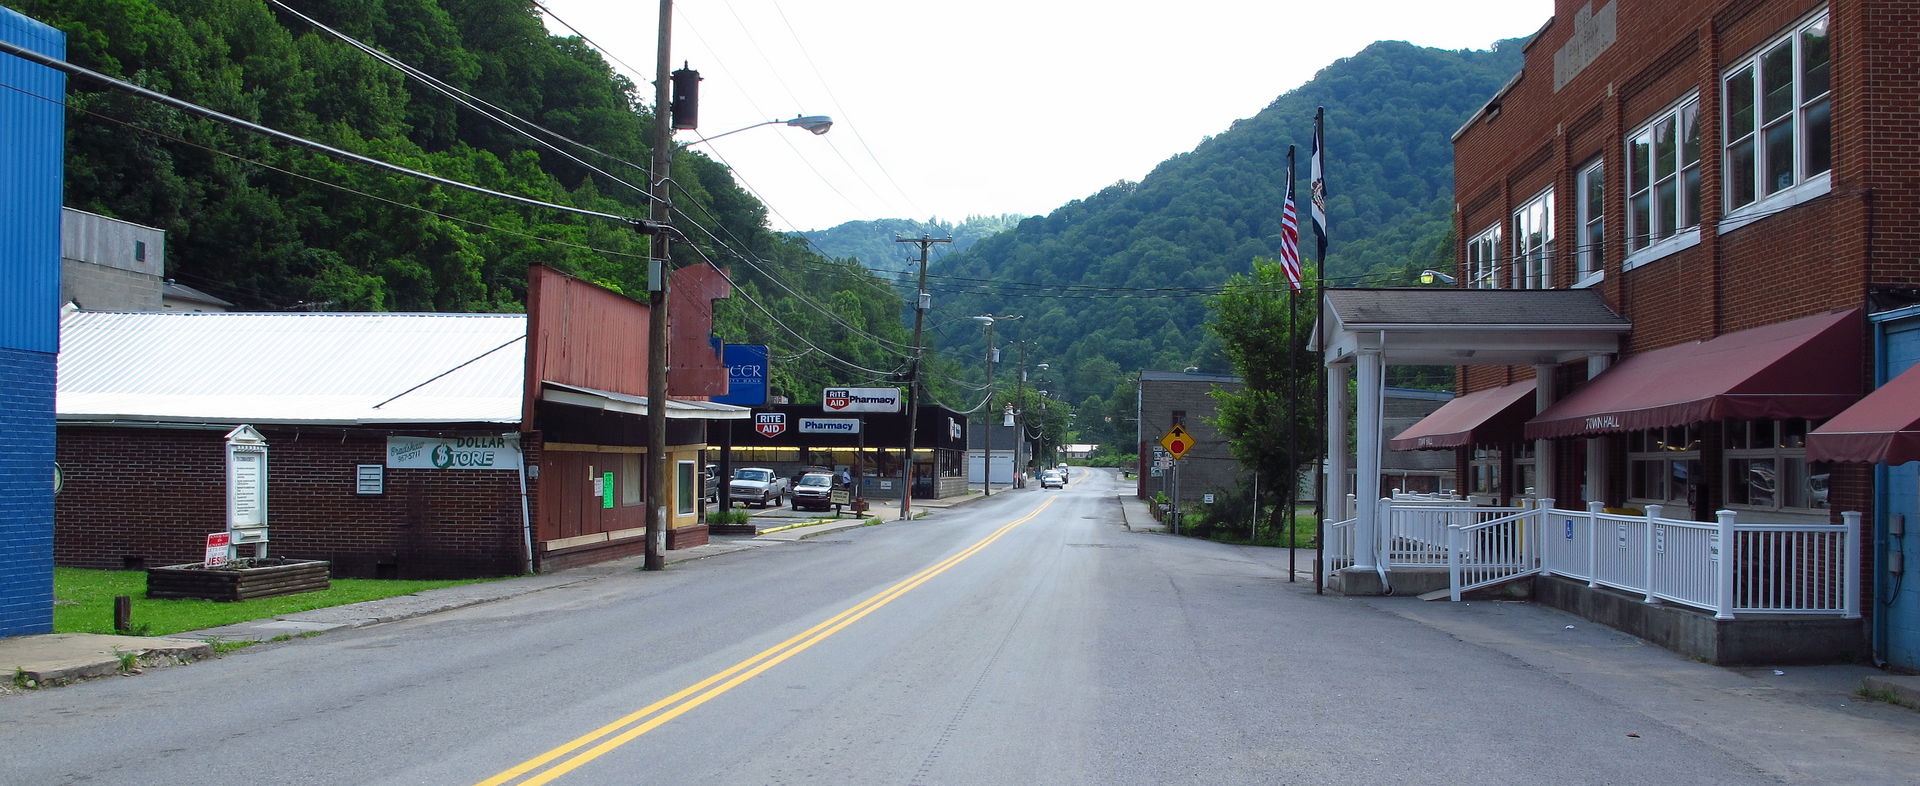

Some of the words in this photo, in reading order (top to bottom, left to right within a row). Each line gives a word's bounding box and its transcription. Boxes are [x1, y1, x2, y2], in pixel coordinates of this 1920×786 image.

[850, 396, 895, 404] Pharmacy
[805, 421, 853, 430] Pharmacy
[1586, 417, 1602, 429] TOWN
[1604, 416, 1619, 427] HALL
[457, 438, 504, 448] DOLLAR
[207, 556, 227, 566] JESUS
